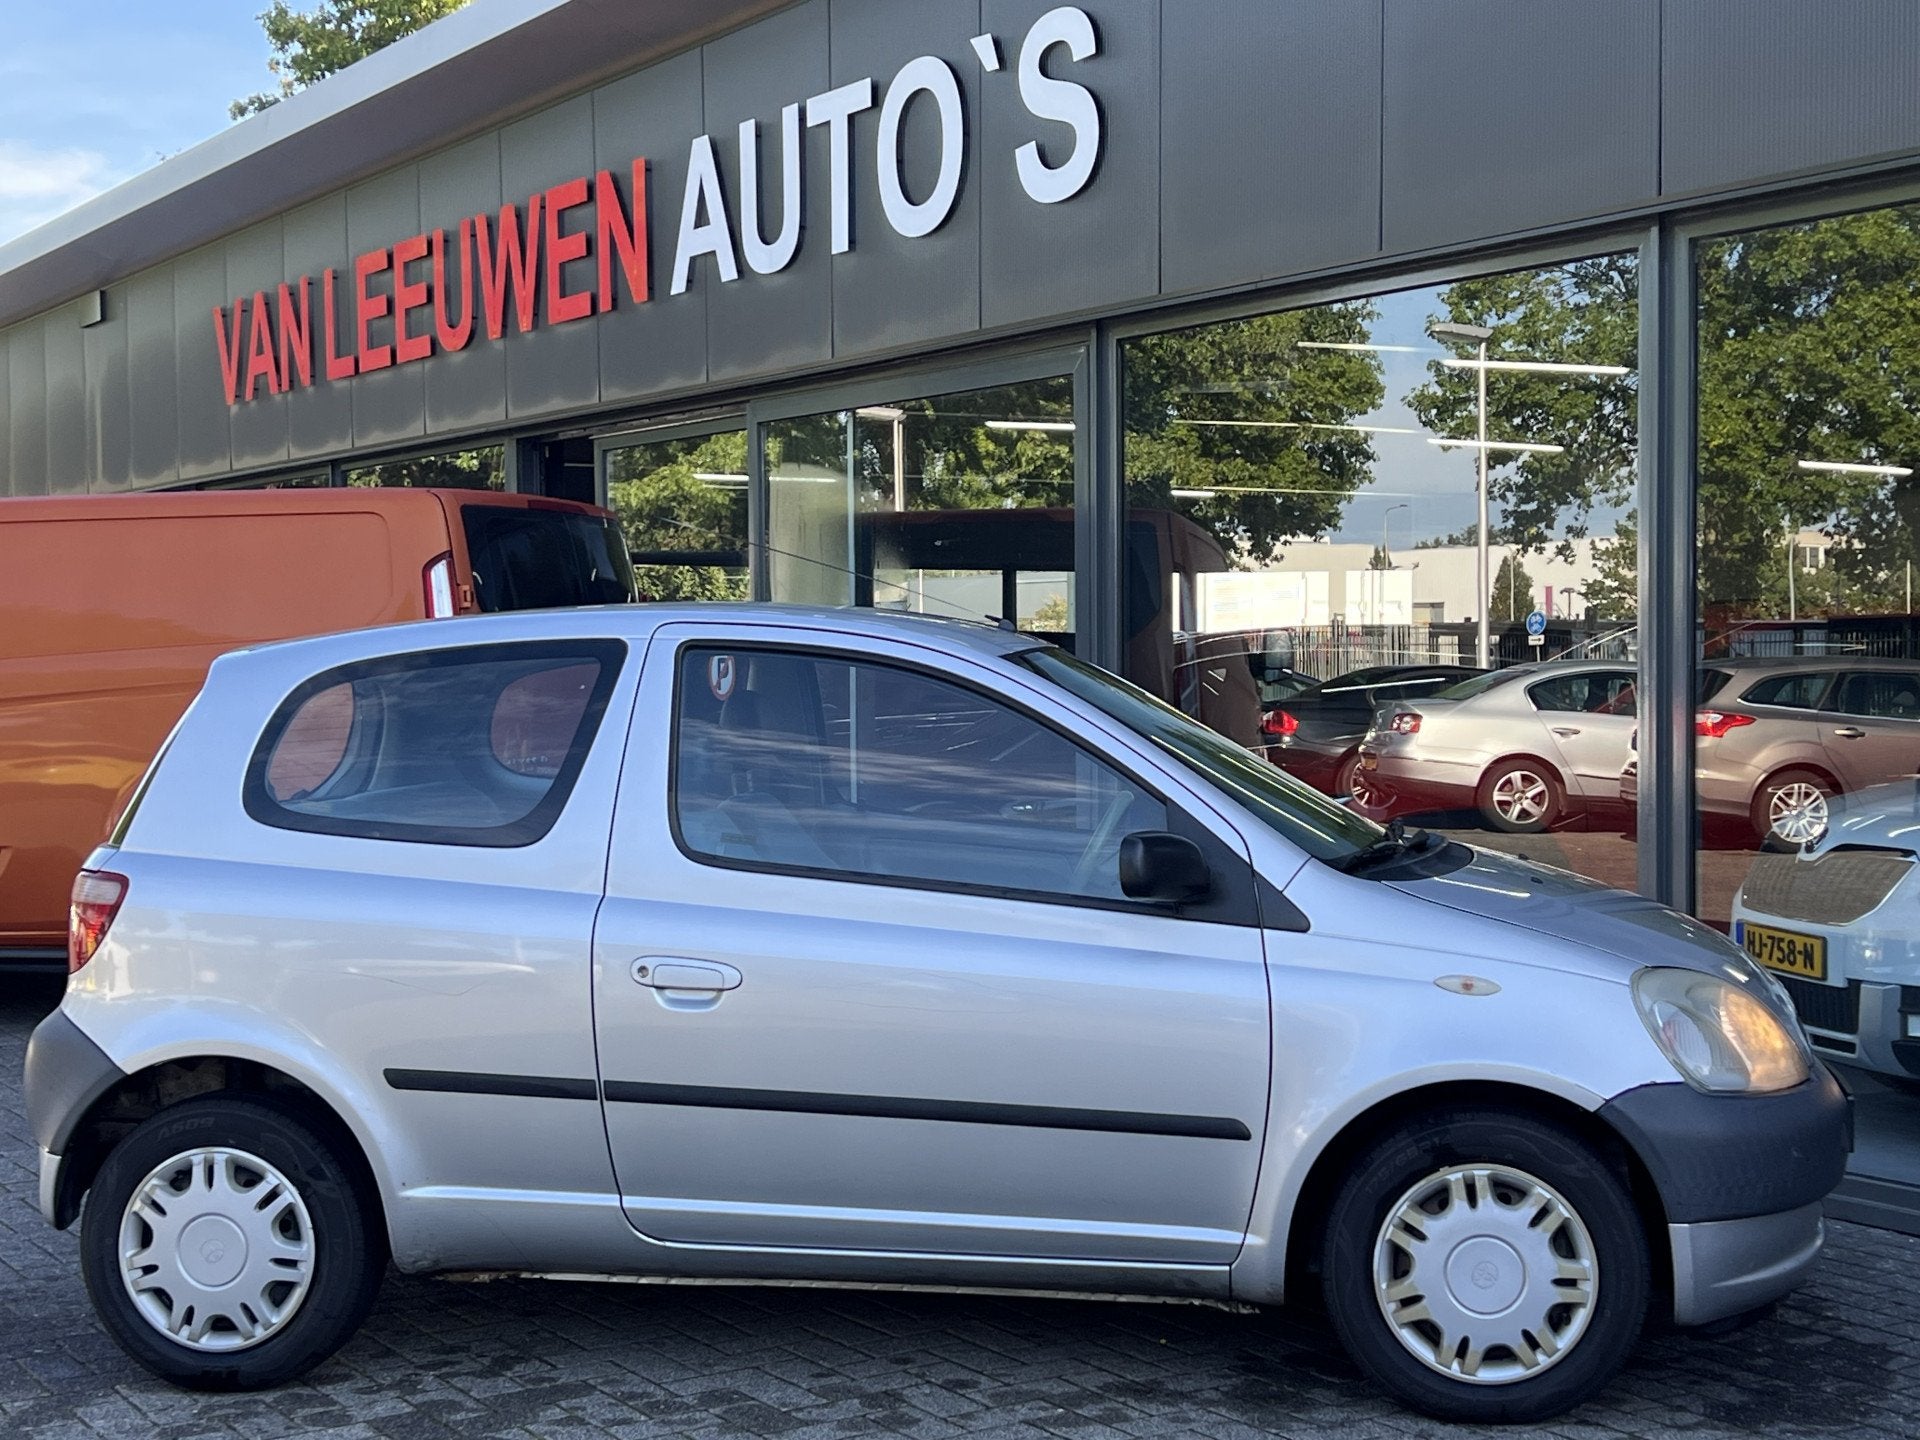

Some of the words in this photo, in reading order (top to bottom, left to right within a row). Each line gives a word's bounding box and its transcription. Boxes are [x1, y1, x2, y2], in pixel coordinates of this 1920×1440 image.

[213, 276, 311, 405] VAN
[324, 157, 649, 381] LEEUWEN
[1747, 930, 1815, 971] HJ-758-N
